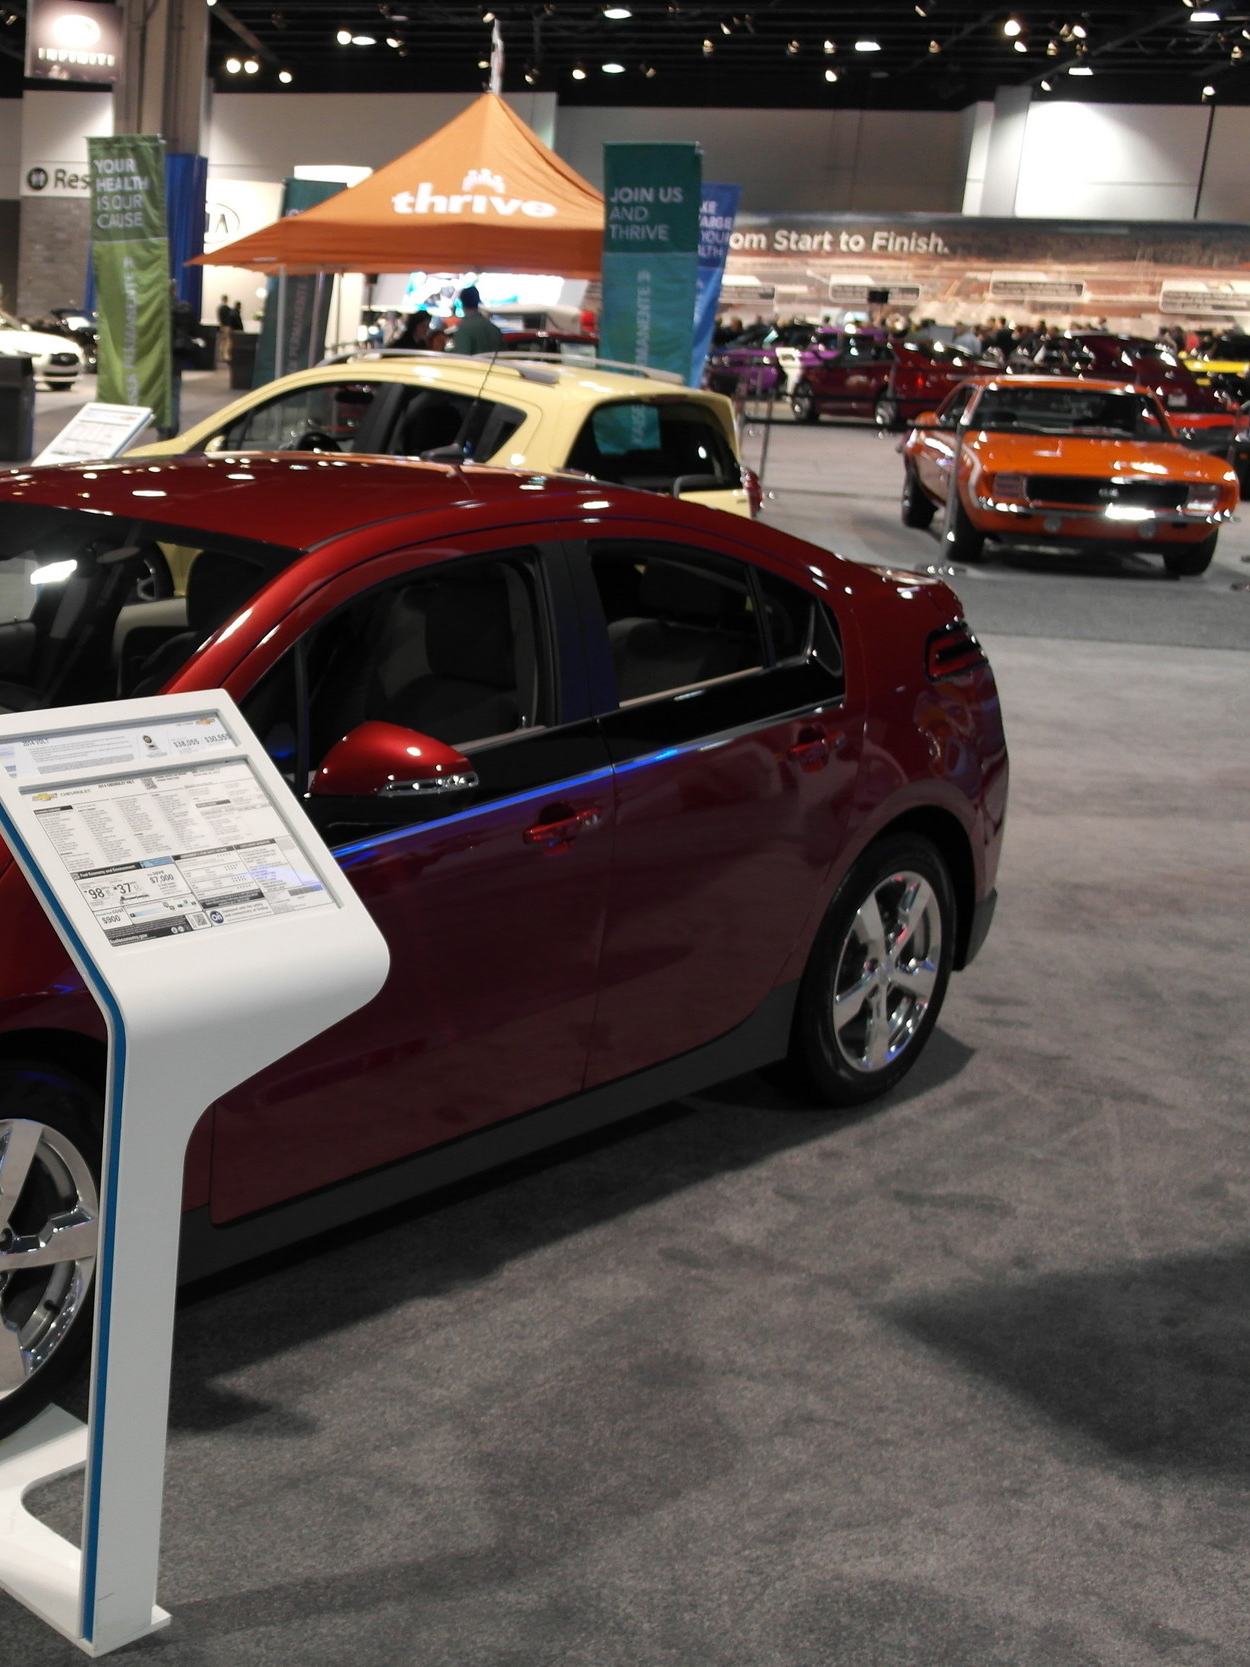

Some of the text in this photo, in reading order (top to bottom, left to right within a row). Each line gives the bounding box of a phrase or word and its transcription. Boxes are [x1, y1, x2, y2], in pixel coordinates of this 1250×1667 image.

[94, 158, 136, 174] YOUR
[96, 175, 149, 192] HEALTH
[97, 194, 142, 210] IS OUR
[391, 182, 557, 218] thrive
[610, 186, 684, 203] JOIN US
[97, 212, 143, 229] CAUSE
[609, 206, 648, 222] AND
[610, 224, 670, 240] THRIVE
[774, 230, 832, 251] Start
[839, 230, 866, 252] to
[872, 231, 950, 254] Finish.
[88, 882, 131, 900] 98 37
[102, 914, 120, 924] $900
